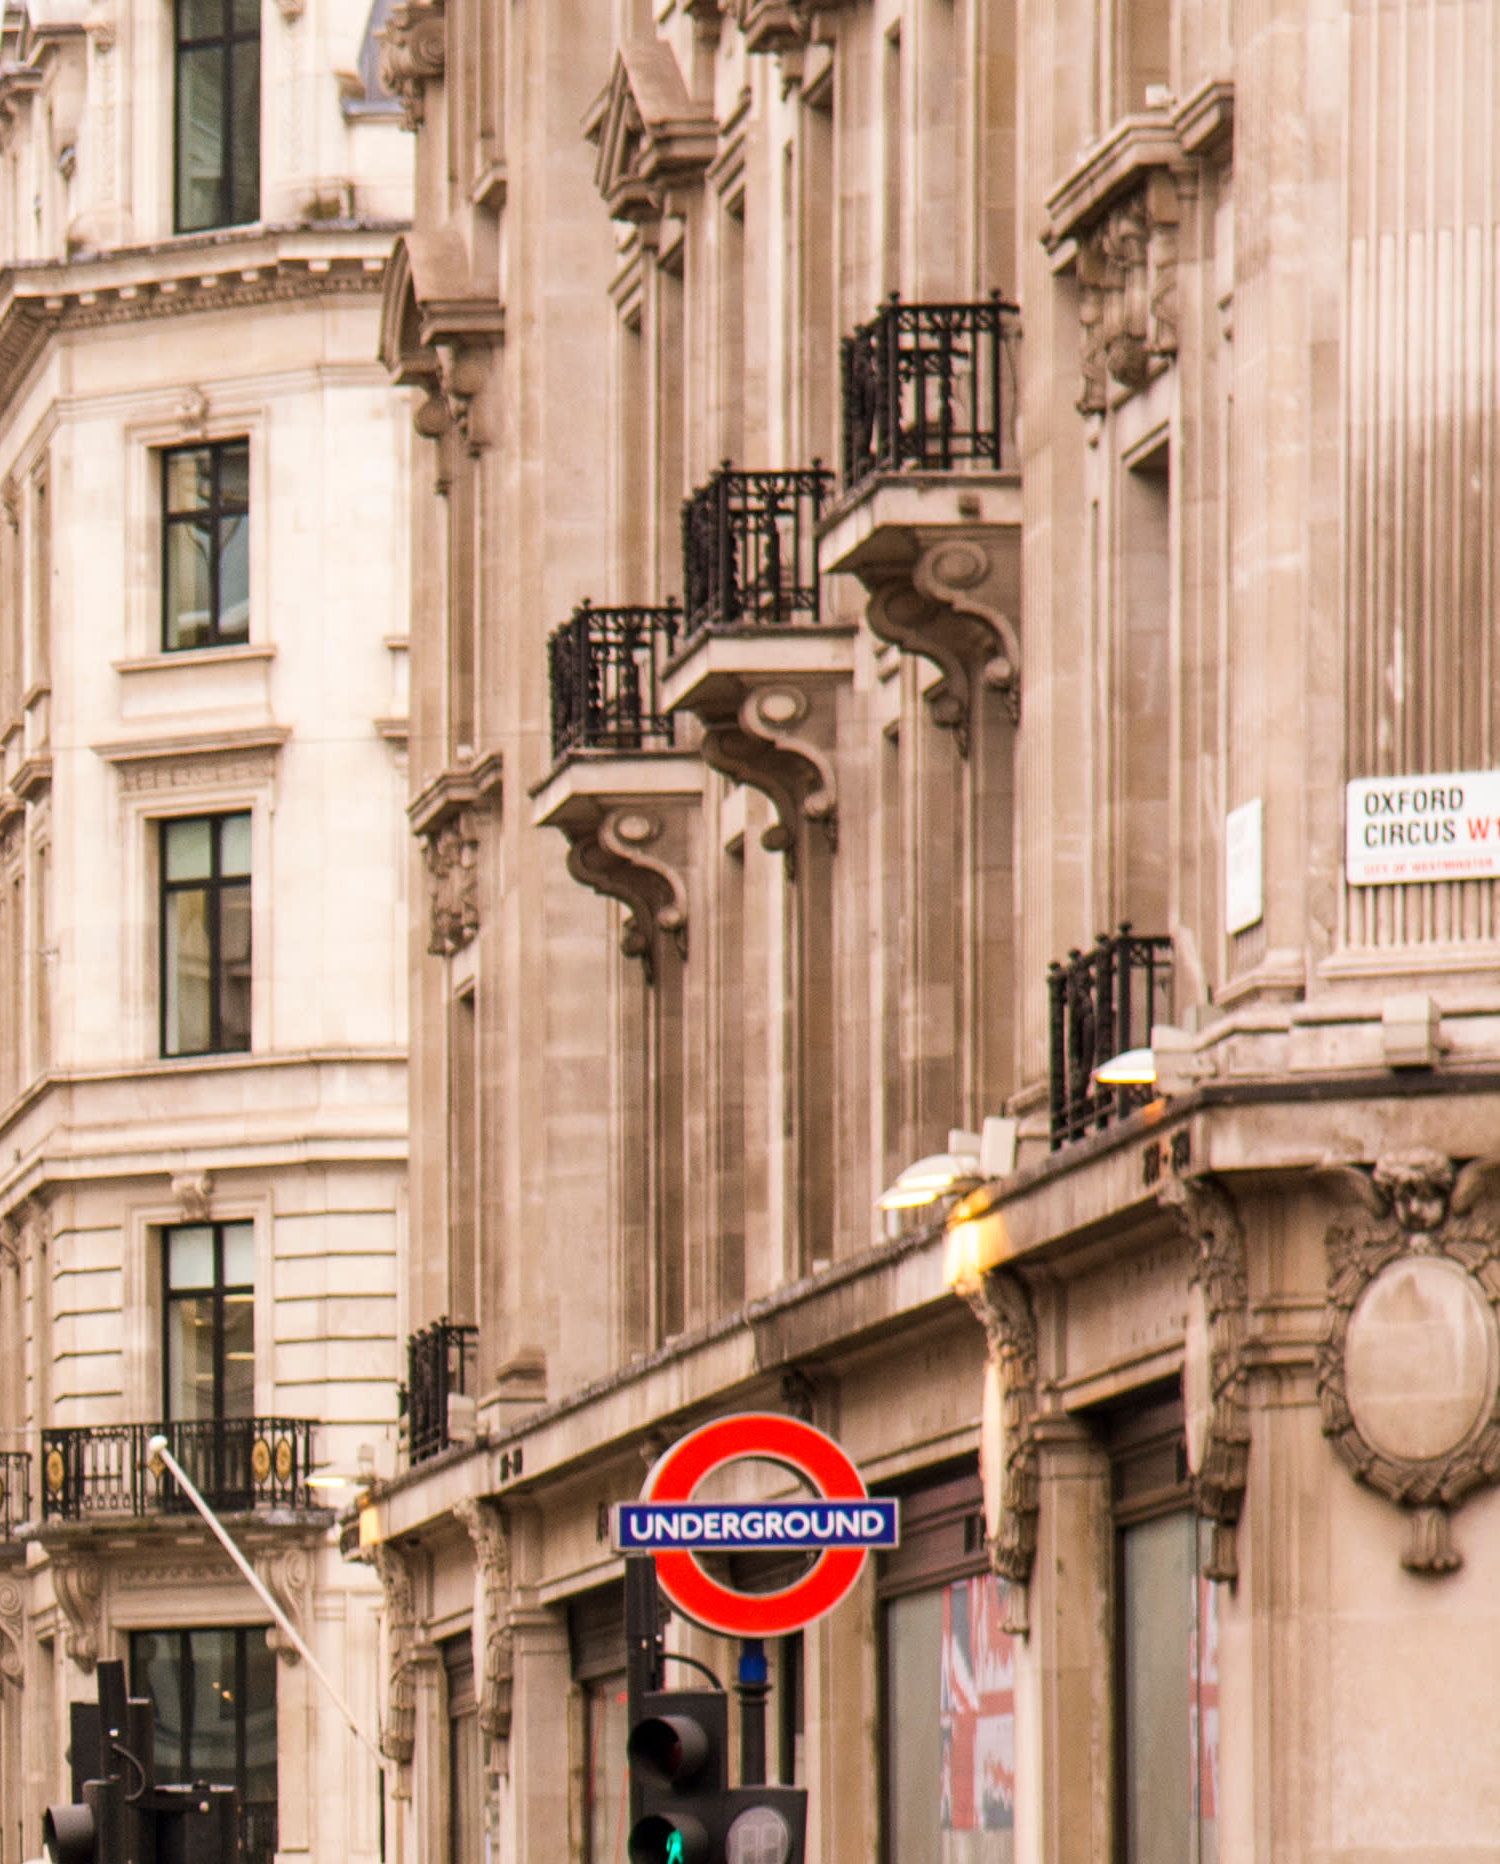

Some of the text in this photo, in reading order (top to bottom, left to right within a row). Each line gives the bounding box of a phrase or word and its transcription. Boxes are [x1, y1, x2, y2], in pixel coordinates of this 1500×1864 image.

[1364, 787, 1464, 816] OXFORD
[1364, 818, 1456, 848] CIRCUS
[1411, 857, 1494, 873] WESTMINSTER
[630, 1510, 885, 1541] UNDERGROUND
